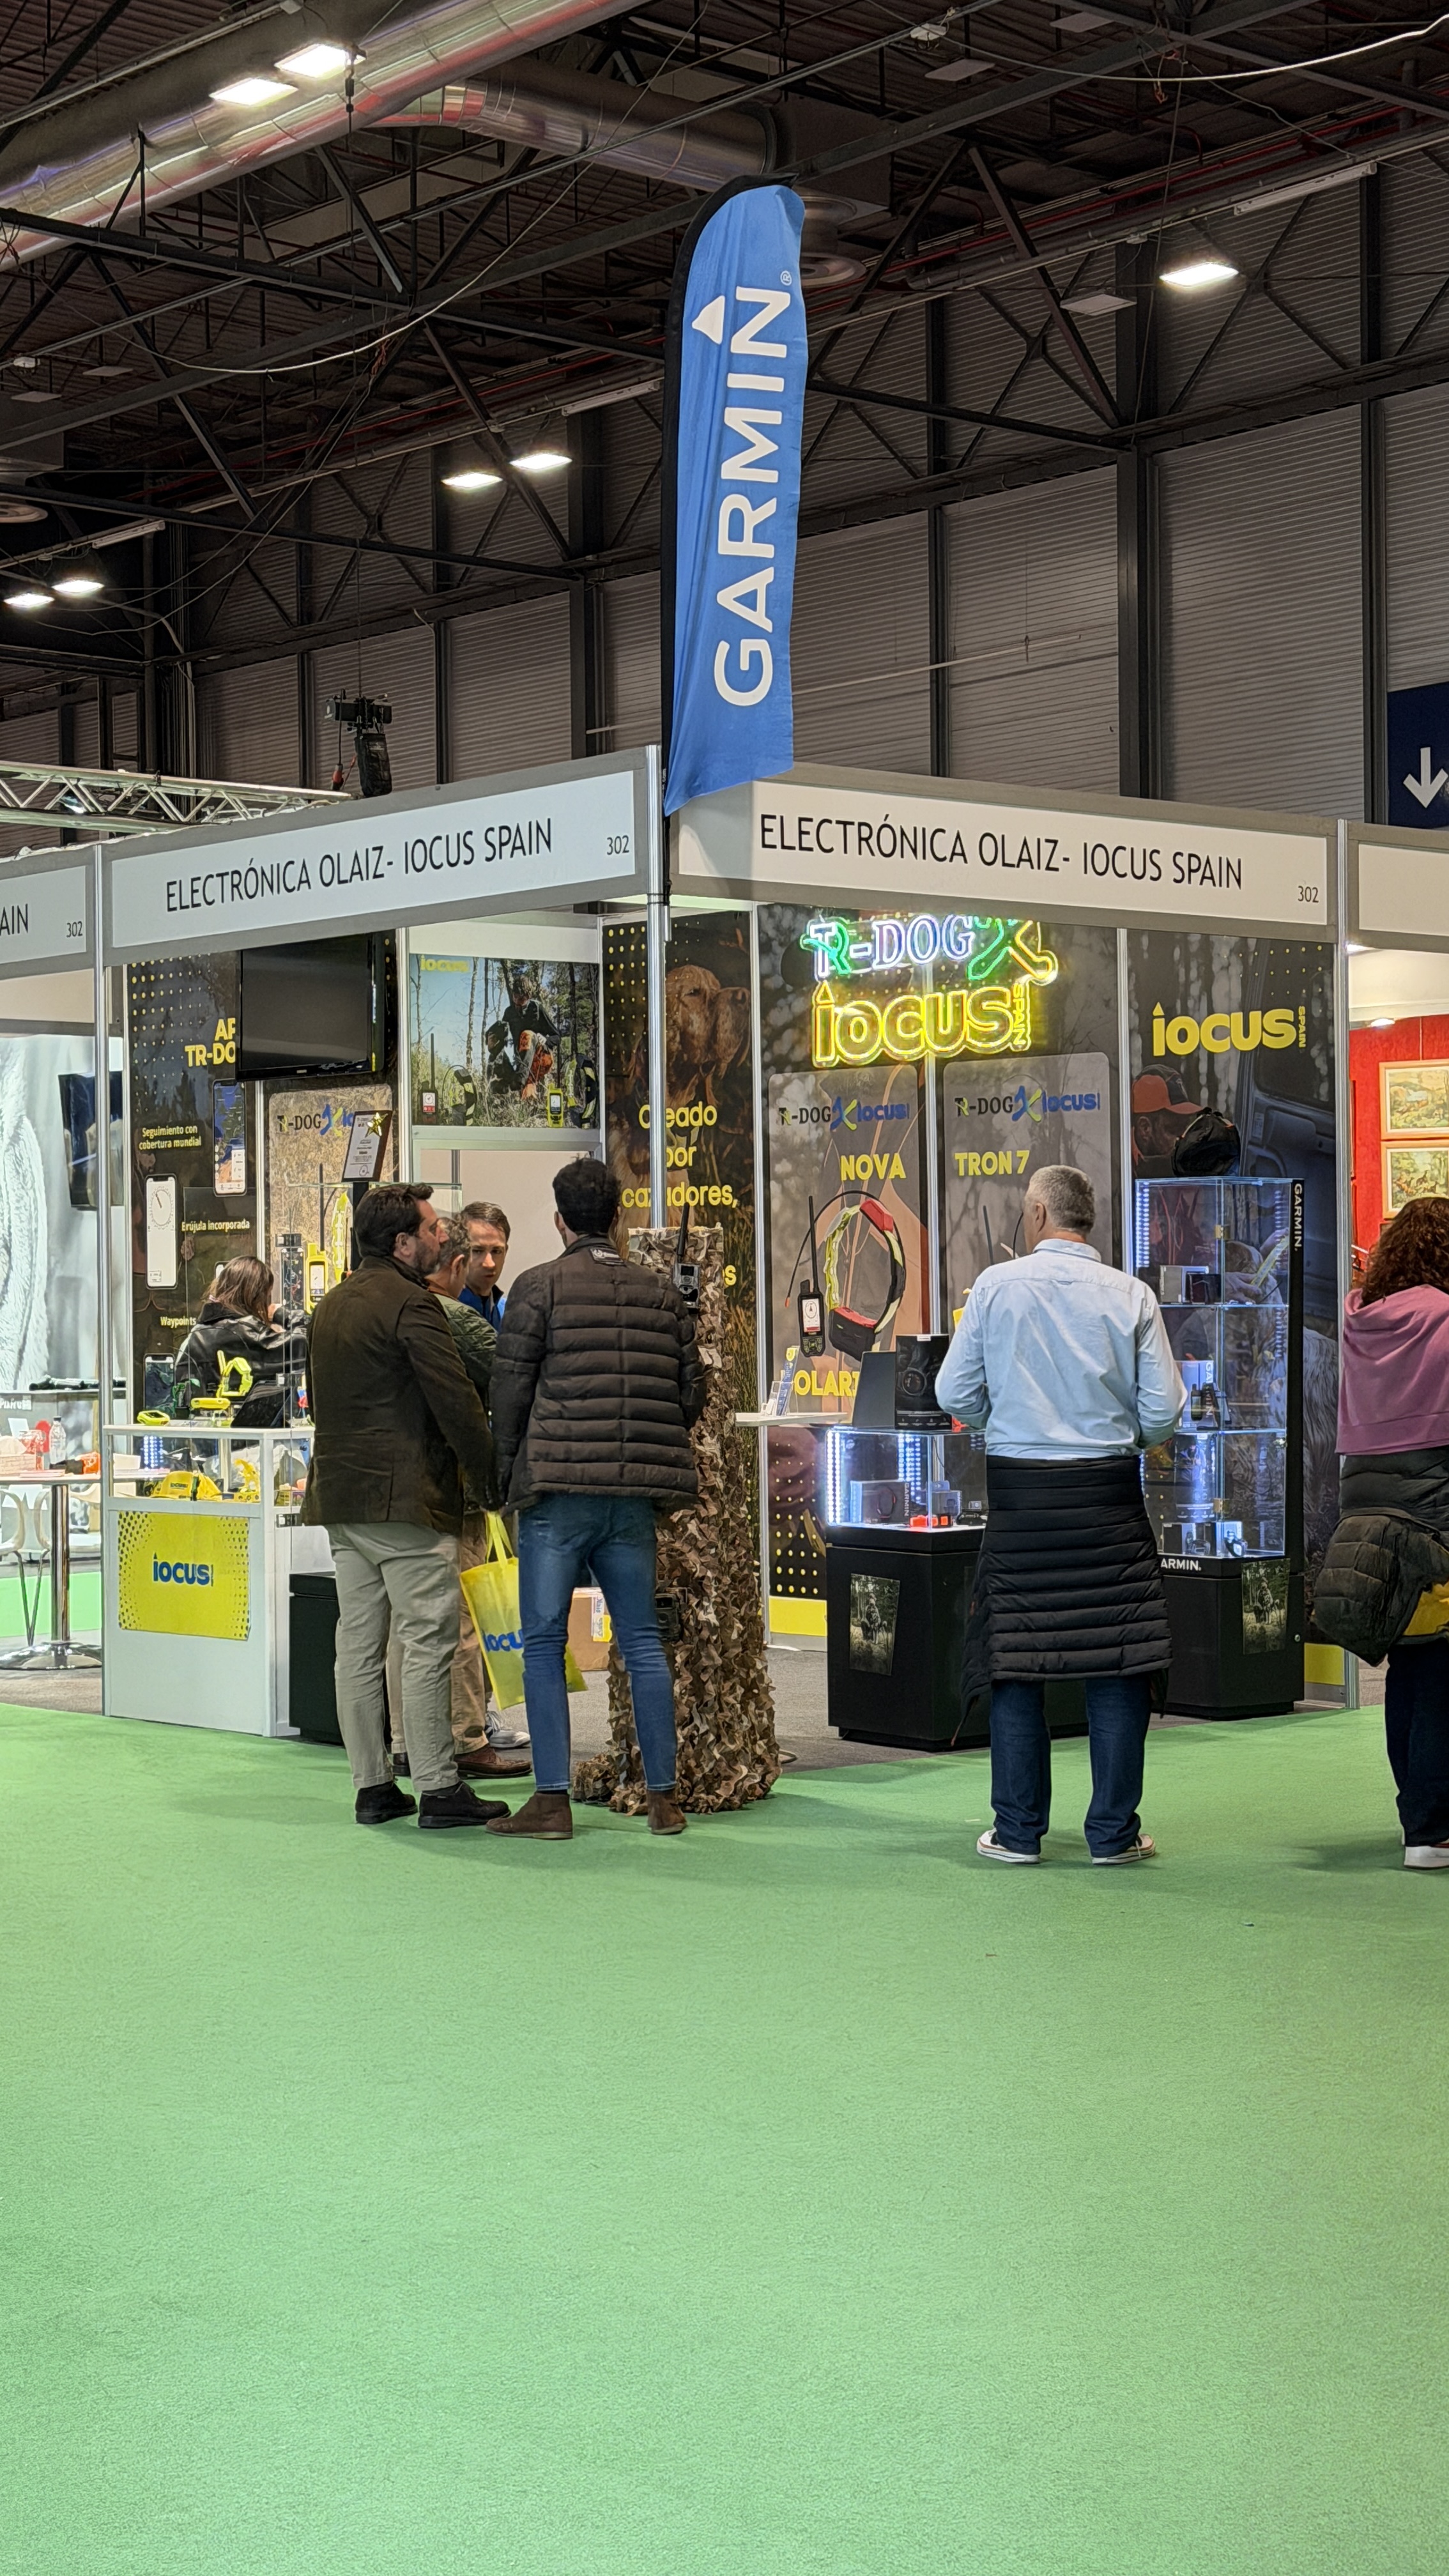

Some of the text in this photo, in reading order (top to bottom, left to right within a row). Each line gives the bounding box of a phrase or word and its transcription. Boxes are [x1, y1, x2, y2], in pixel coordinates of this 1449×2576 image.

[606, 835, 630, 855] 302
[760, 814, 968, 864] ELECTRÓNICA
[1084, 841, 1162, 882] IOCUS
[1172, 851, 1242, 890] SPAIN
[167, 857, 311, 912] ELECTRÓNICA
[404, 831, 475, 875] IOCUS
[484, 818, 551, 862] SPAIN
[1297, 885, 1320, 903] 302
[0, 903, 29, 937] AIN
[66, 921, 83, 938] 302
[1298, 1006, 1307, 1048] SPAIN
[185, 1041, 236, 1067] TR-DO
[639, 1101, 717, 1130] Ceado
[139, 1135, 202, 1150] cobertura mundial
[142, 1125, 198, 1139] Seguimiento con
[841, 1153, 907, 1181] NOVA
[954, 1150, 1030, 1176] TRON 7
[622, 1181, 737, 1209] cadores,
[208, 1218, 250, 1232] incorporada
[160, 1315, 197, 1328] Waypoints
